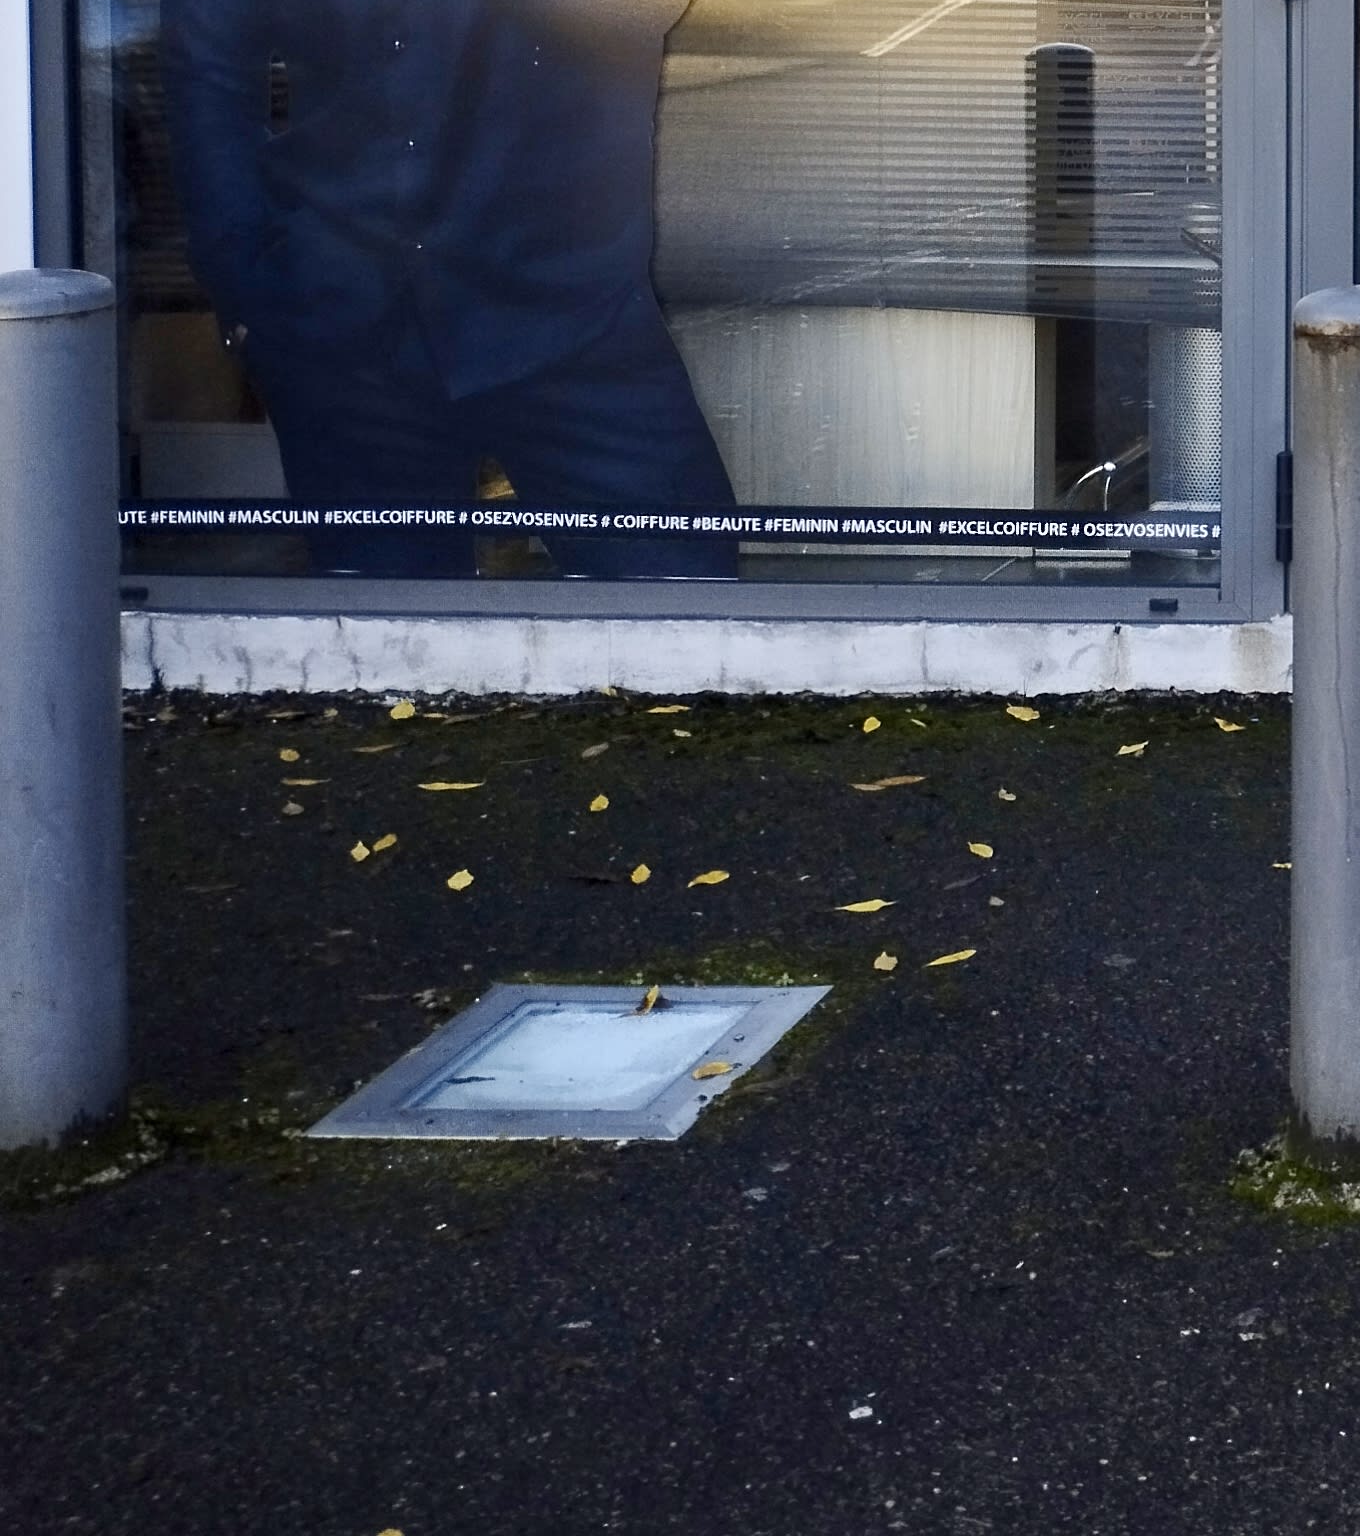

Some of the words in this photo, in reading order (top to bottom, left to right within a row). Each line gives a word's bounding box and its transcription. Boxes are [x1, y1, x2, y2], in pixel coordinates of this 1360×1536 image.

[150, 510, 225, 524] #FEMININ
[228, 510, 319, 524] #MASCULIN
[324, 510, 456, 524] #EXCELCOIFFURE
[471, 511, 598, 528] OSEZVOSENVIES
[613, 514, 689, 530] COIFFURE
[692, 516, 761, 532] #BEAUTE
[764, 518, 839, 533] #FEMININ
[841, 519, 932, 534] #MASCULIN
[938, 520, 1068, 537] #EXCELCOIFFURE
[1083, 522, 1209, 538] OSEZVOSENVIES
